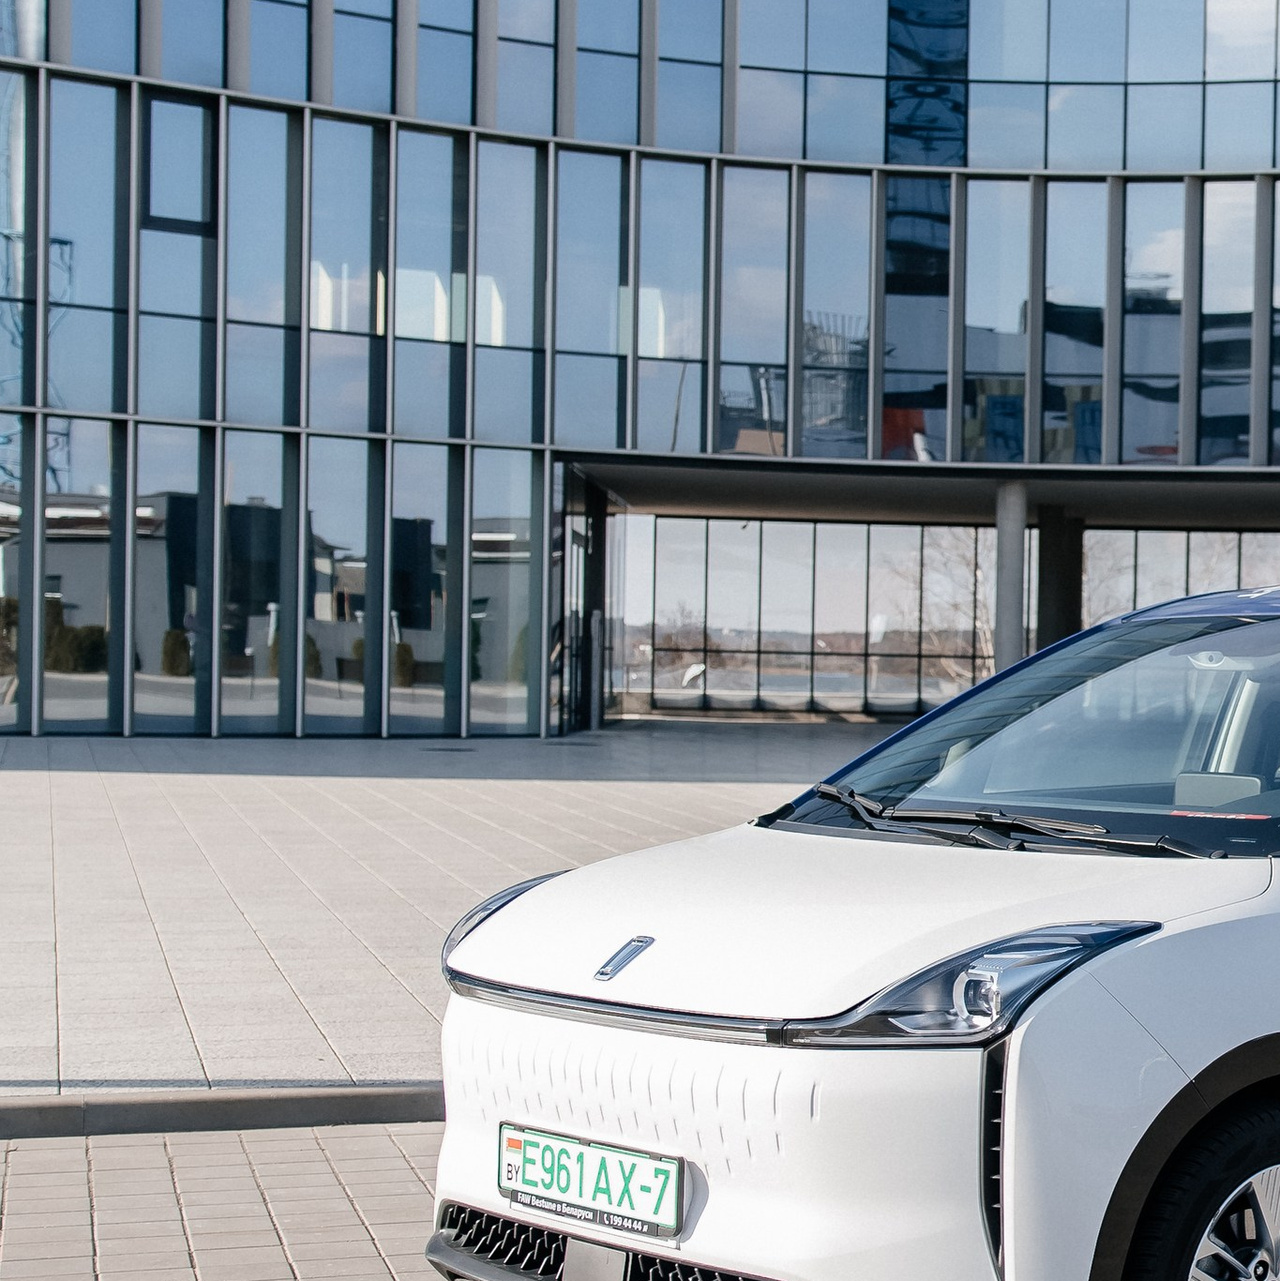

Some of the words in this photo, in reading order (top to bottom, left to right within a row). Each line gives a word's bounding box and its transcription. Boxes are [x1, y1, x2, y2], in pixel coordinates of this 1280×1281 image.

[506, 1162, 521, 1182] BY
[517, 1192, 531, 1205] FAW
[531, 1195, 556, 1211] Bestune
[562, 1203, 593, 1219] Беларуси
[609, 1214, 623, 1227] 199
